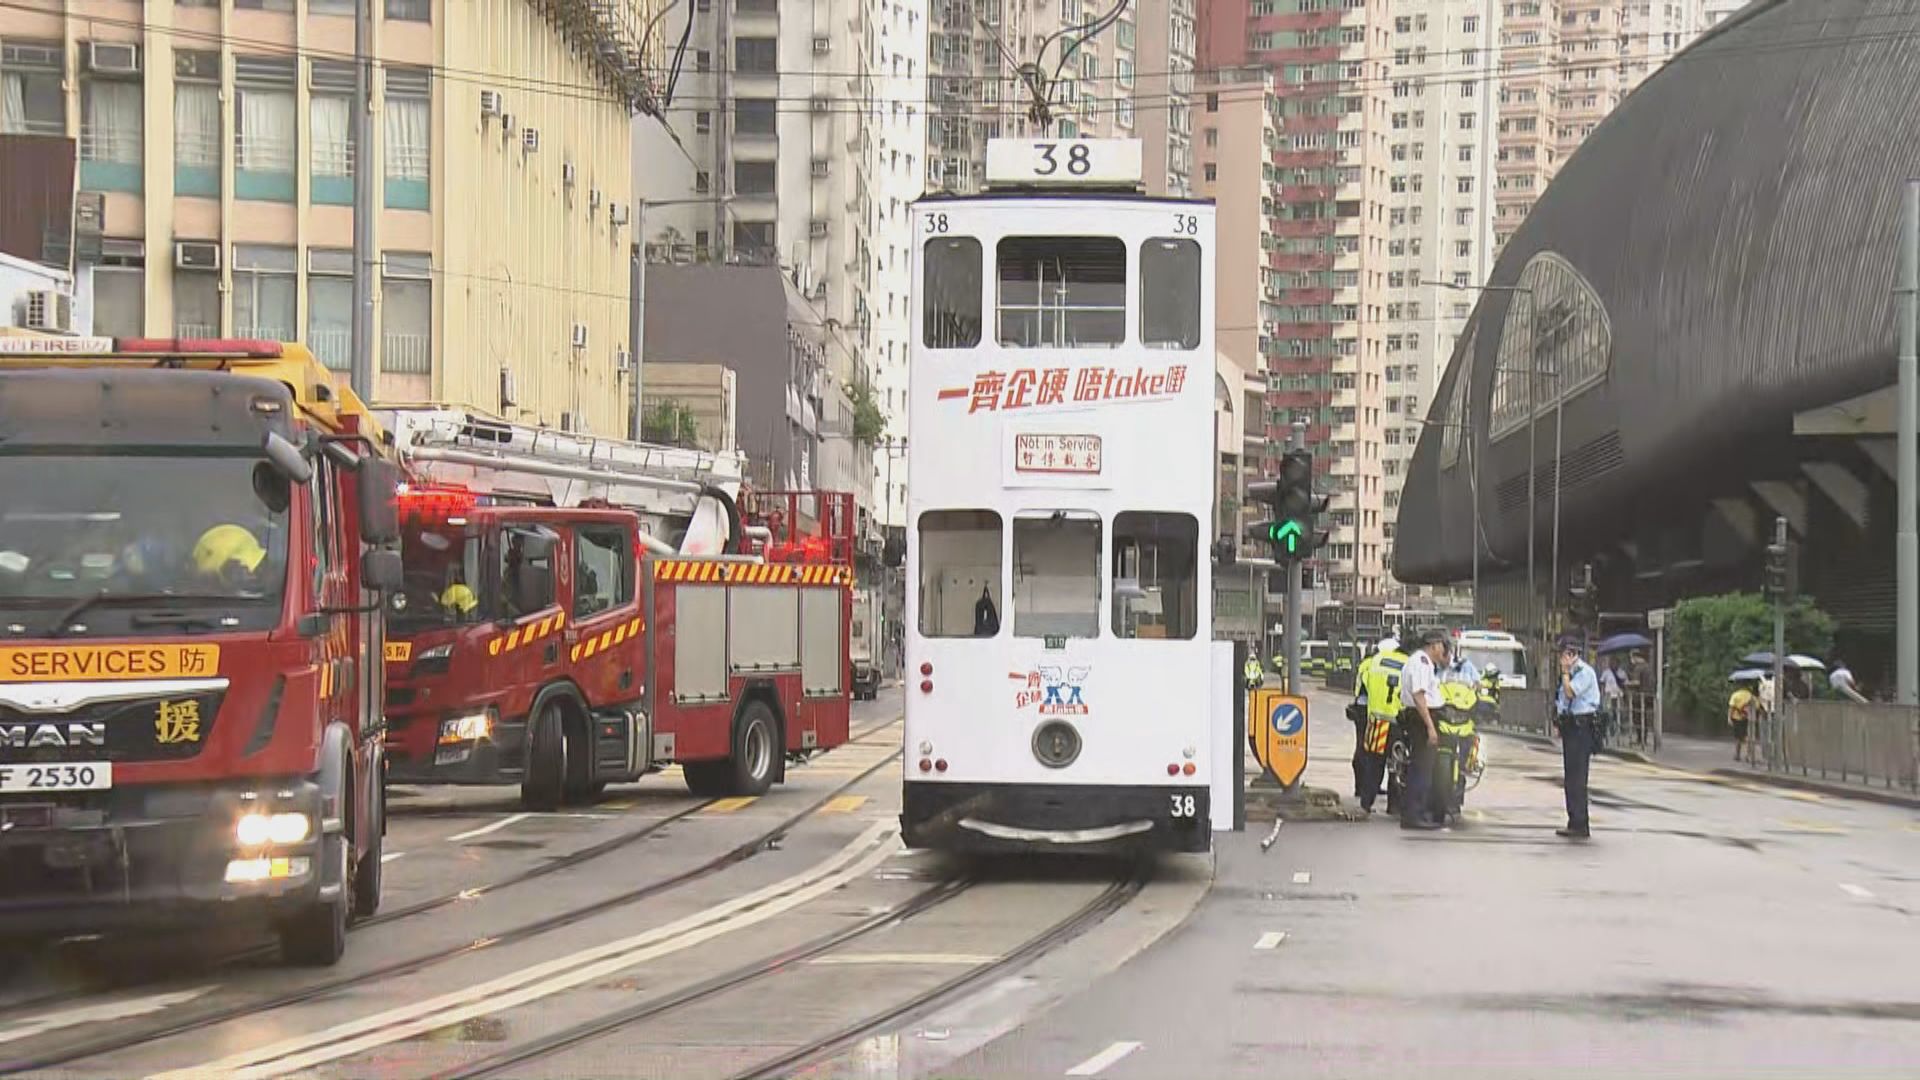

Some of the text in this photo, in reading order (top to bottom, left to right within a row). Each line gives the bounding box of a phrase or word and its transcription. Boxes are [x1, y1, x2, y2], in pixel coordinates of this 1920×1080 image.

[1033, 143, 1091, 175] 38
[924, 213, 949, 233] 38
[1173, 214, 1198, 235] 38
[31, 339, 80, 351] FIRE
[937, 367, 1070, 414] 一齊企硬
[1020, 435, 1100, 451] Not in Service
[11, 648, 207, 675] SERVICES 防
[155, 700, 200, 743] 援
[0, 723, 105, 747] MAN
[26, 766, 95, 787] 2530
[1170, 795, 1195, 817] 38
